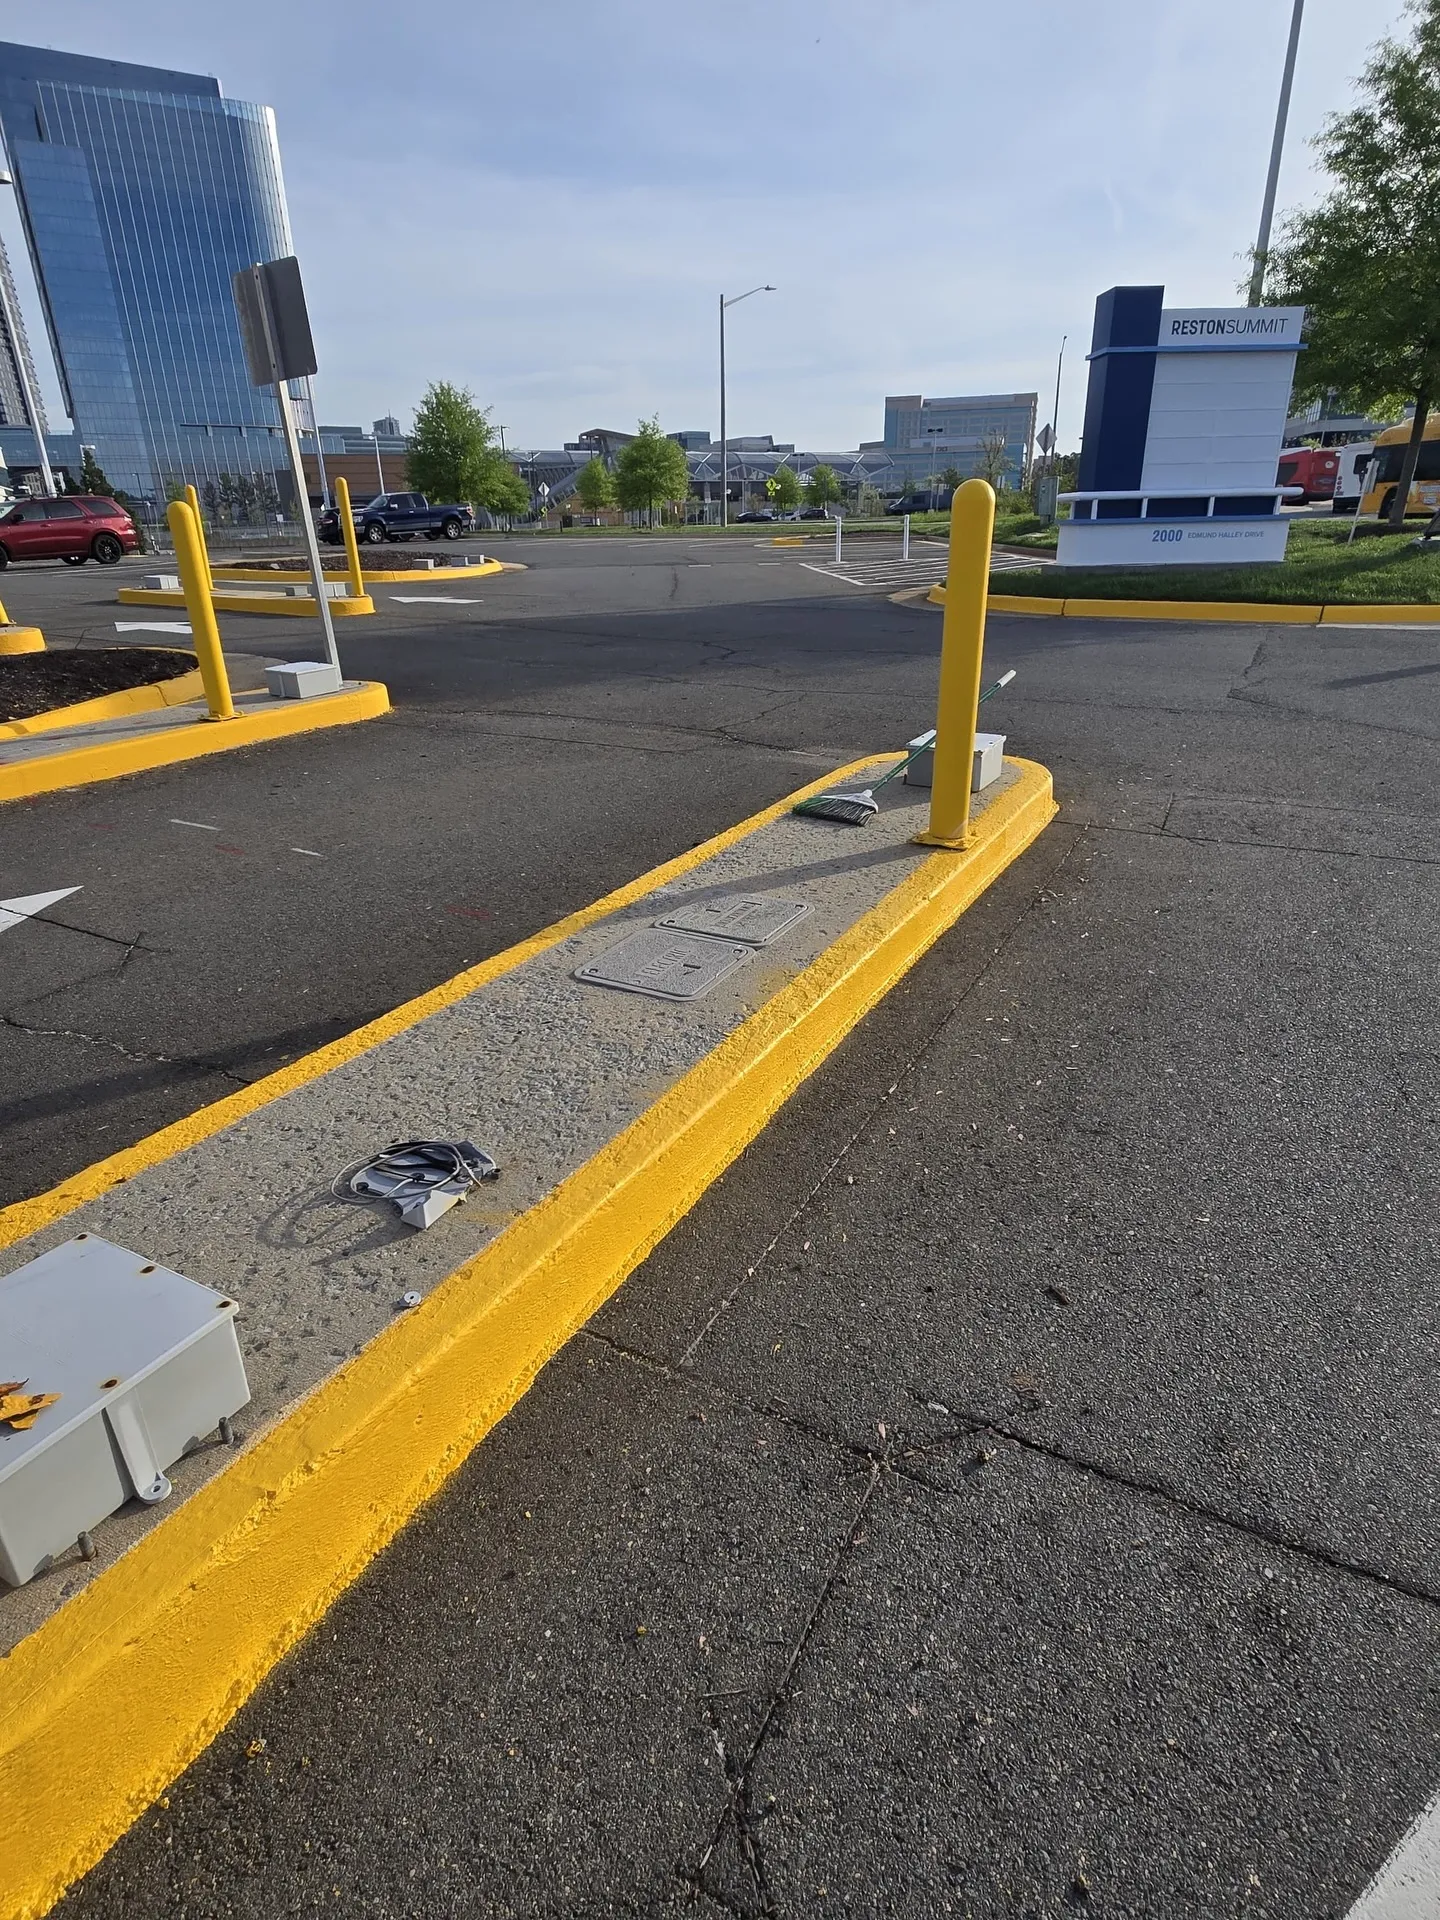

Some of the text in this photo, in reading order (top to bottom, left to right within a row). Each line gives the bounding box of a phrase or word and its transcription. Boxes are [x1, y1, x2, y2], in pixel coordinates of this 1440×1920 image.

[1151, 529, 1183, 542] 2000
[1187, 531, 1217, 539] EDMUND
[641, 948, 690, 976] ELECTRIC
